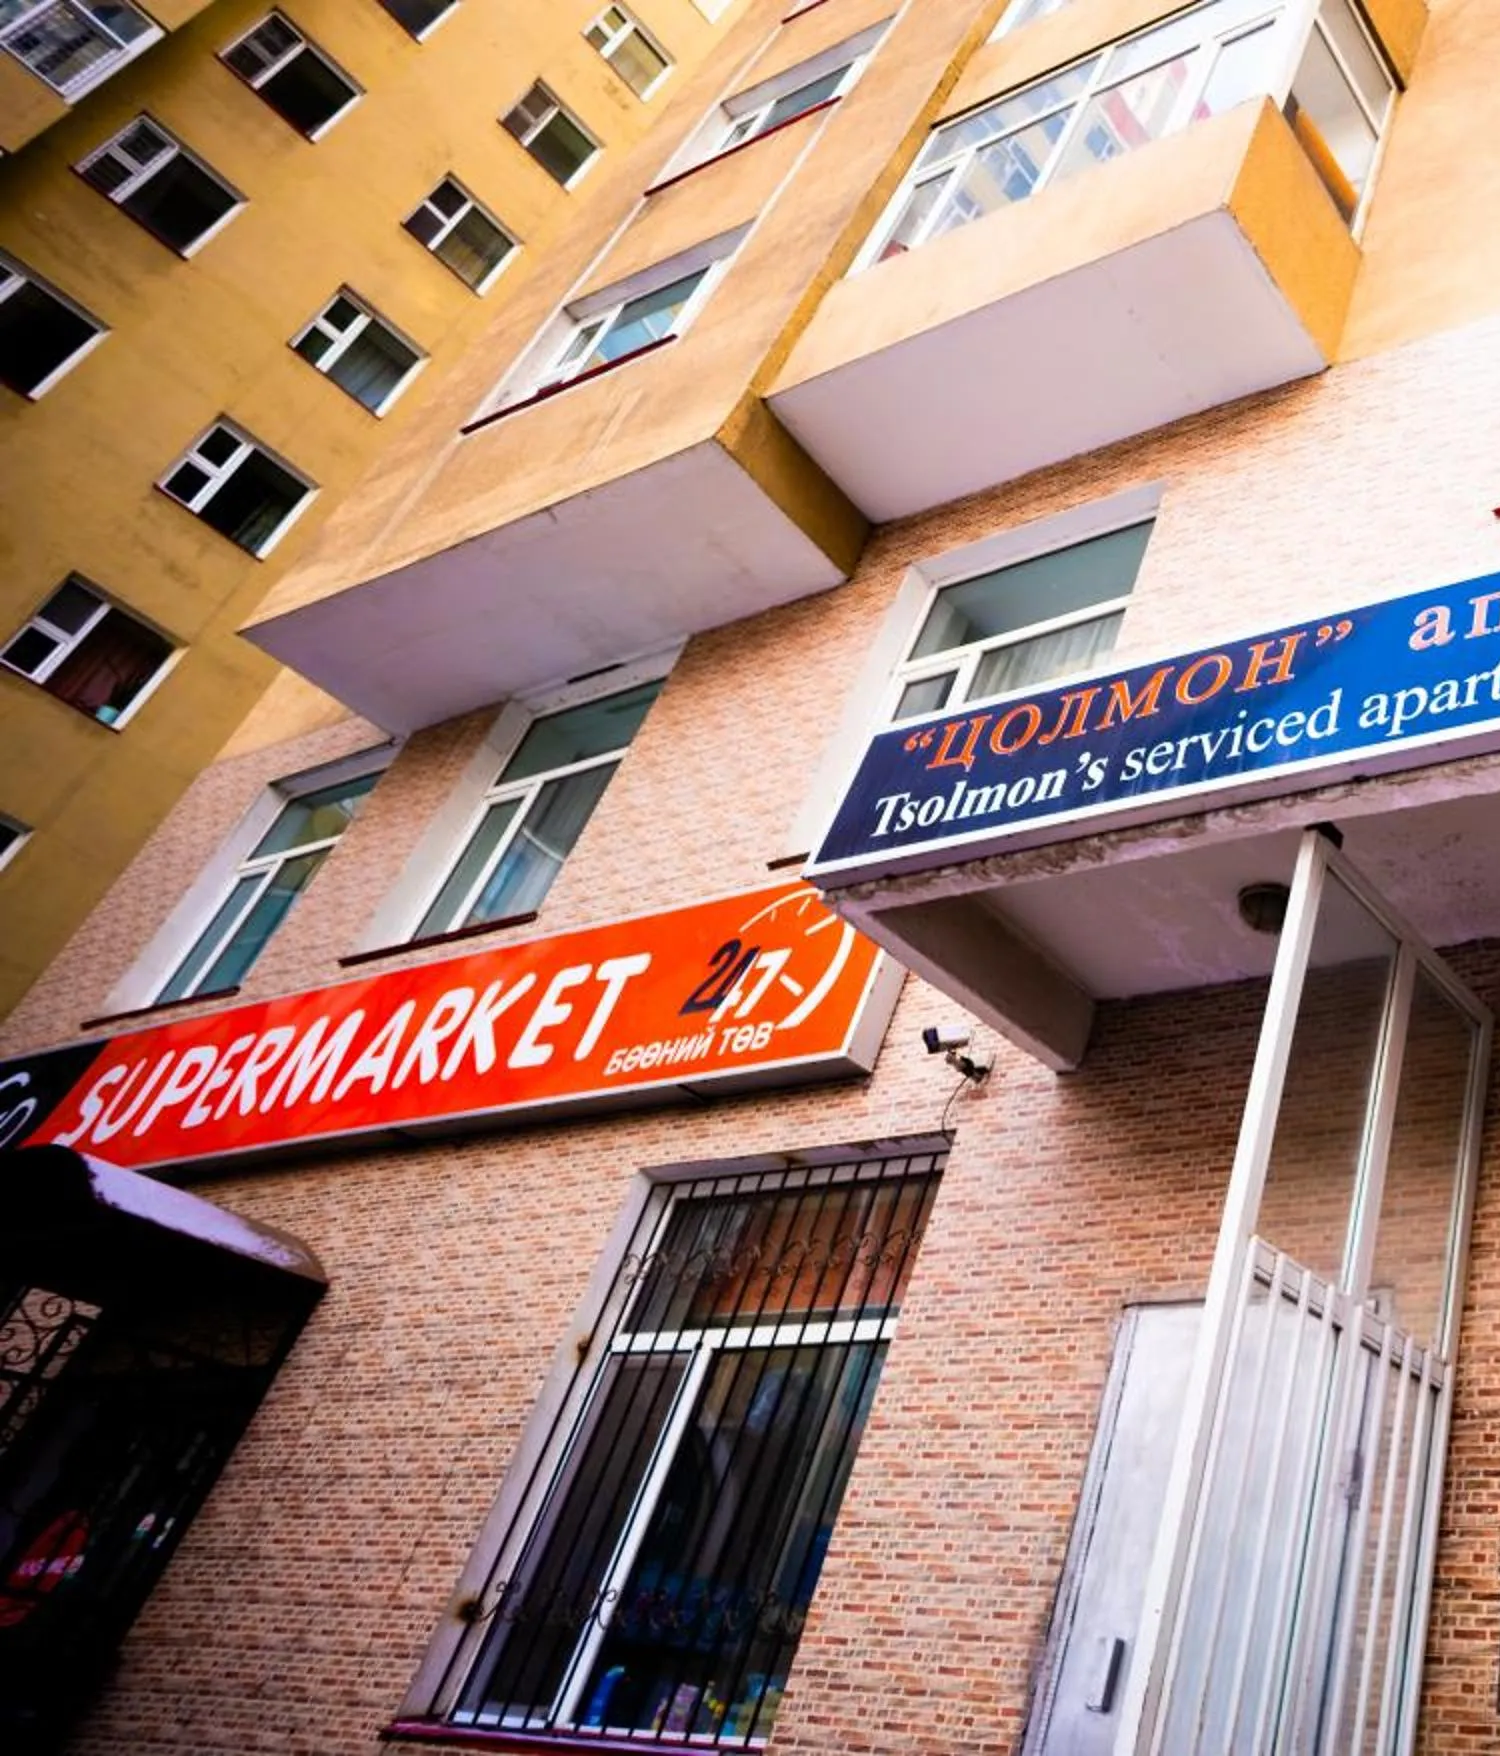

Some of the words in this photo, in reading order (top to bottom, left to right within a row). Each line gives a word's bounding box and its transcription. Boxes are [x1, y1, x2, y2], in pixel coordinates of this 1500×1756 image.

[870, 751, 1108, 838] Tsolmon’s
[1120, 688, 1343, 781] serviced
[51, 952, 651, 1147] SUPERMARKET
